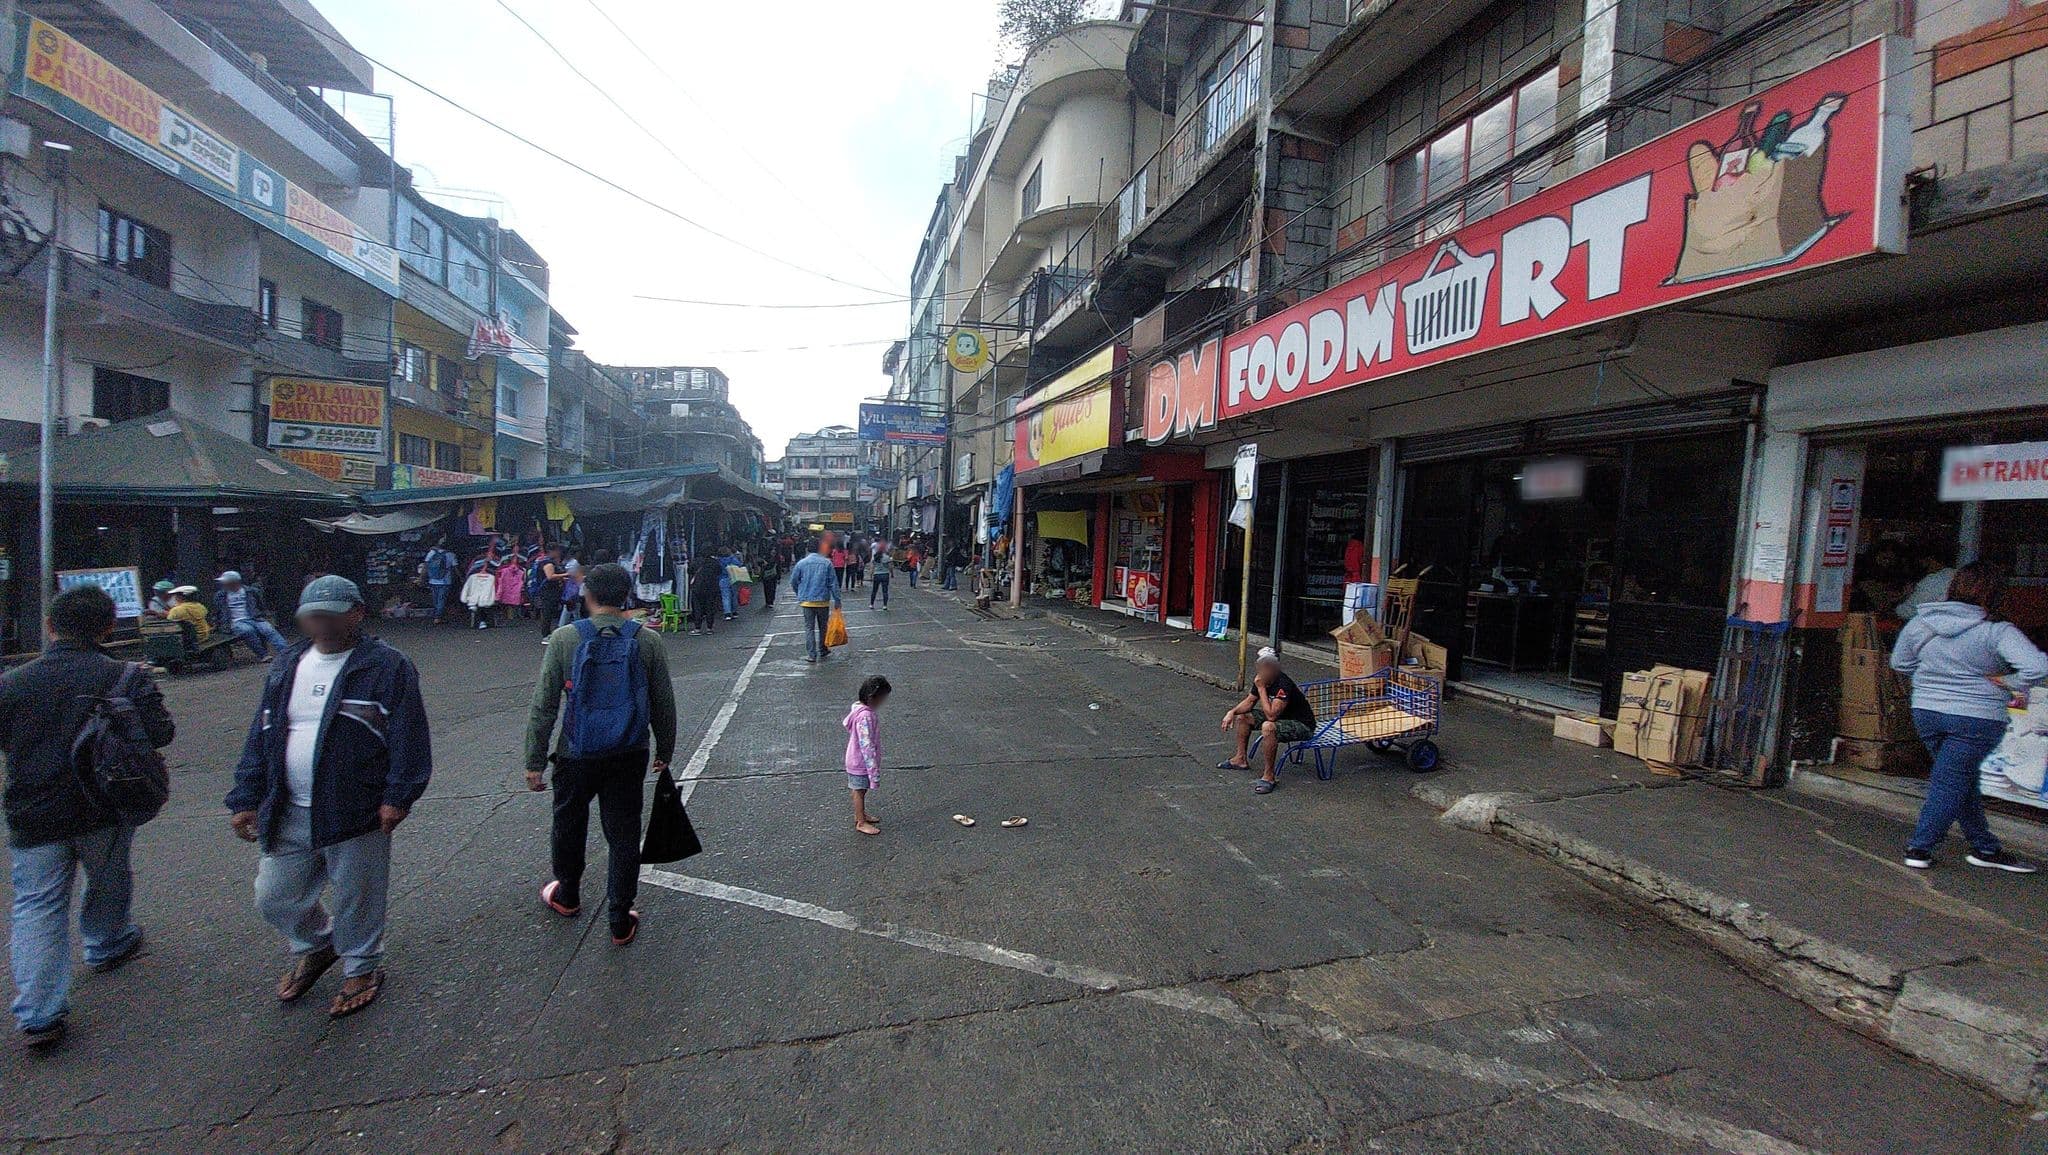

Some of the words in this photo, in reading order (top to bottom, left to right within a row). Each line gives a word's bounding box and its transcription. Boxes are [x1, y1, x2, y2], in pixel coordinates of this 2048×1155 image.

[33, 52, 159, 142] PAWNSHOP
[62, 40, 160, 124] PALAWAN
[274, 401, 380, 425] PAWNSHOP
[296, 383, 380, 407] PALAWAN
[1145, 337, 1222, 445] DM
